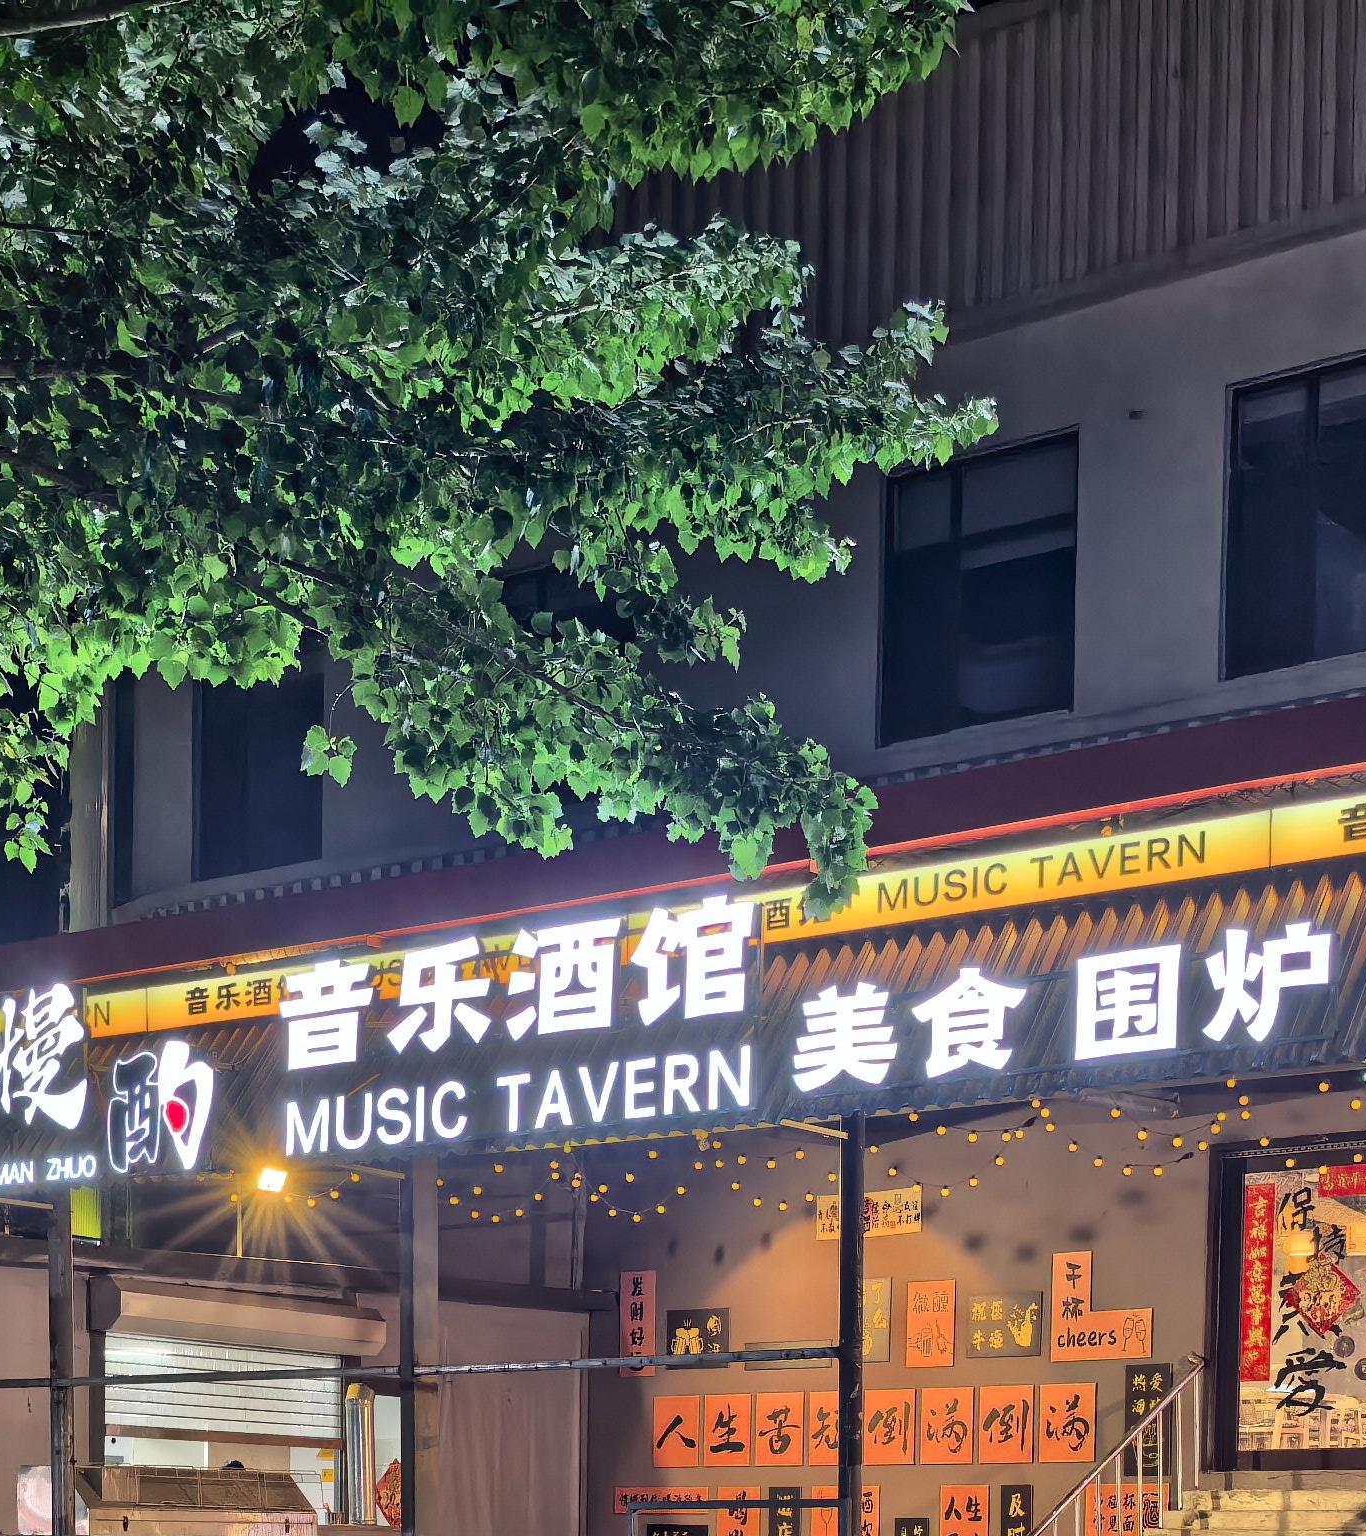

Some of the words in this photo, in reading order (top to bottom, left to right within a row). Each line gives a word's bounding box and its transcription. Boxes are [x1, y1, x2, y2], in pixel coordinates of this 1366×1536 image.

[877, 862, 1008, 913] MUSIC
[1030, 830, 1207, 889] TAVERN
[185, 974, 287, 1016] 音乐酒
[280, 896, 756, 1071] 音乐酒馆
[792, 966, 1027, 1094] 美食
[1075, 919, 1332, 1062] 围炉
[285, 1080, 468, 1157] MUSIC
[497, 1045, 753, 1133] TAVERN
[46, 1154, 96, 1181] ZHUO
[1061, 1261, 1085, 1320] 干杯
[1057, 1324, 1117, 1349] cheers
[944, 1495, 983, 1521] 人生
